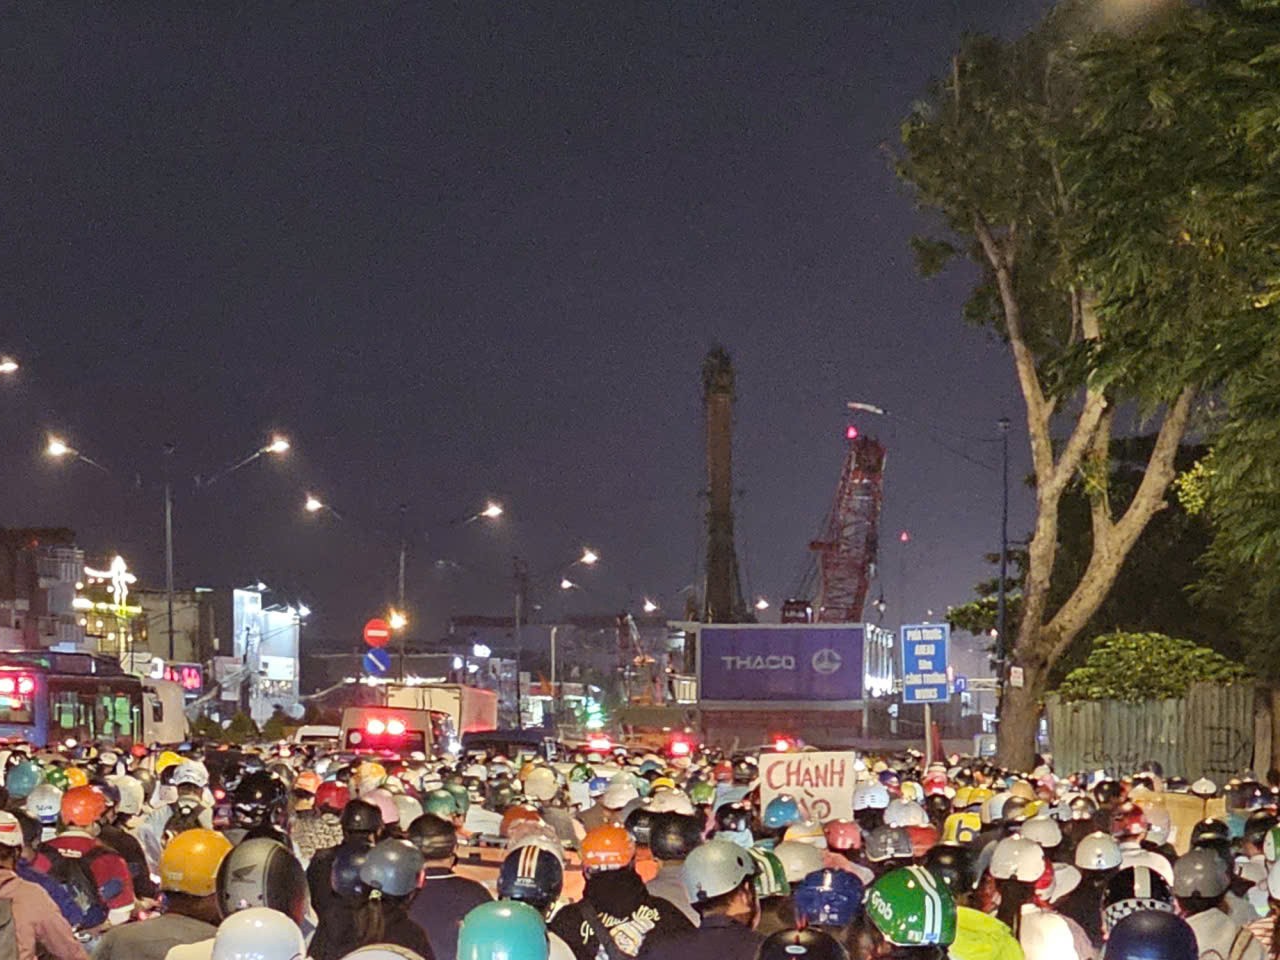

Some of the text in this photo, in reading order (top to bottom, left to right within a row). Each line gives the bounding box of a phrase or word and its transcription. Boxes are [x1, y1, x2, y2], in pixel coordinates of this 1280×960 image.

[721, 655, 795, 669] THACO
[766, 758, 846, 790] CHANH
[870, 889, 894, 921] Grab
